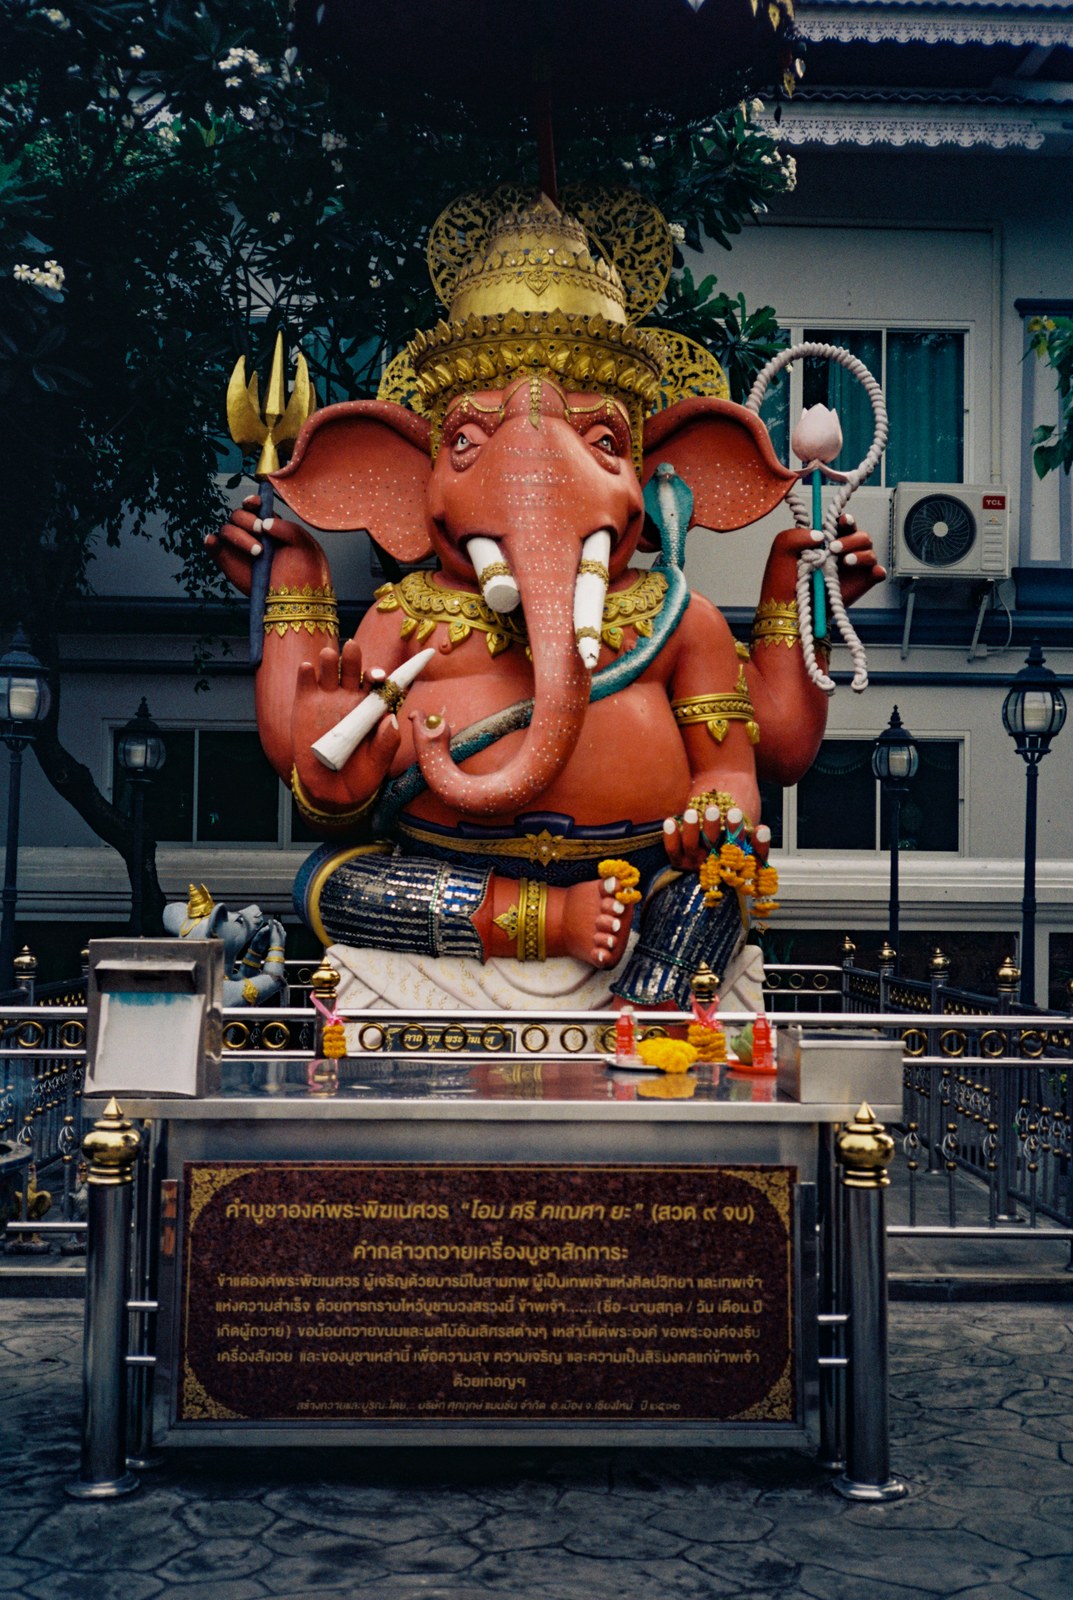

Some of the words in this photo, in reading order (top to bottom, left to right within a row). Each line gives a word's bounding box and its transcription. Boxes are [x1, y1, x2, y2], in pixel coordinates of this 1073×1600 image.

[225, 1198, 450, 1225] คำบูชาองค์พระพิฆเนศวร
[509, 1200, 537, 1220] ศรี
[540, 1204, 605, 1220] คเณศา
[651, 1204, 697, 1223] (สวด
[703, 1205, 716, 1220] ๙
[722, 1204, 755, 1224] จบ)
[352, 1236, 629, 1266] คำกล่าวถวายเครื่องบูชาสักการะ
[217, 1273, 360, 1288] ข้าแต่องค์พระพิฆเนศวร
[697, 1275, 763, 1289] และเทพเจ้า
[215, 1296, 311, 1313] แห่งความสำเร็จ
[315, 1295, 514, 1316] ด้วยการกราบไหว้บูชาบวงสรวงนี้
[696, 1300, 714, 1313] วัน
[717, 1299, 750, 1313] เดือน
[752, 1299, 763, 1314] ปี
[216, 1322, 292, 1341] เกิดผู้ถวาย)
[662, 1324, 761, 1339] ขอพระองค์จงรับ
[217, 1345, 293, 1363] เครื่องสังเวย
[299, 1344, 410, 1365] และของบูชาเหล่านี้
[413, 1345, 490, 1366] เพื่อความสุข
[493, 1350, 562, 1365] ความเจริญ
[452, 1373, 527, 1388] ด้วยเทอญฯ
